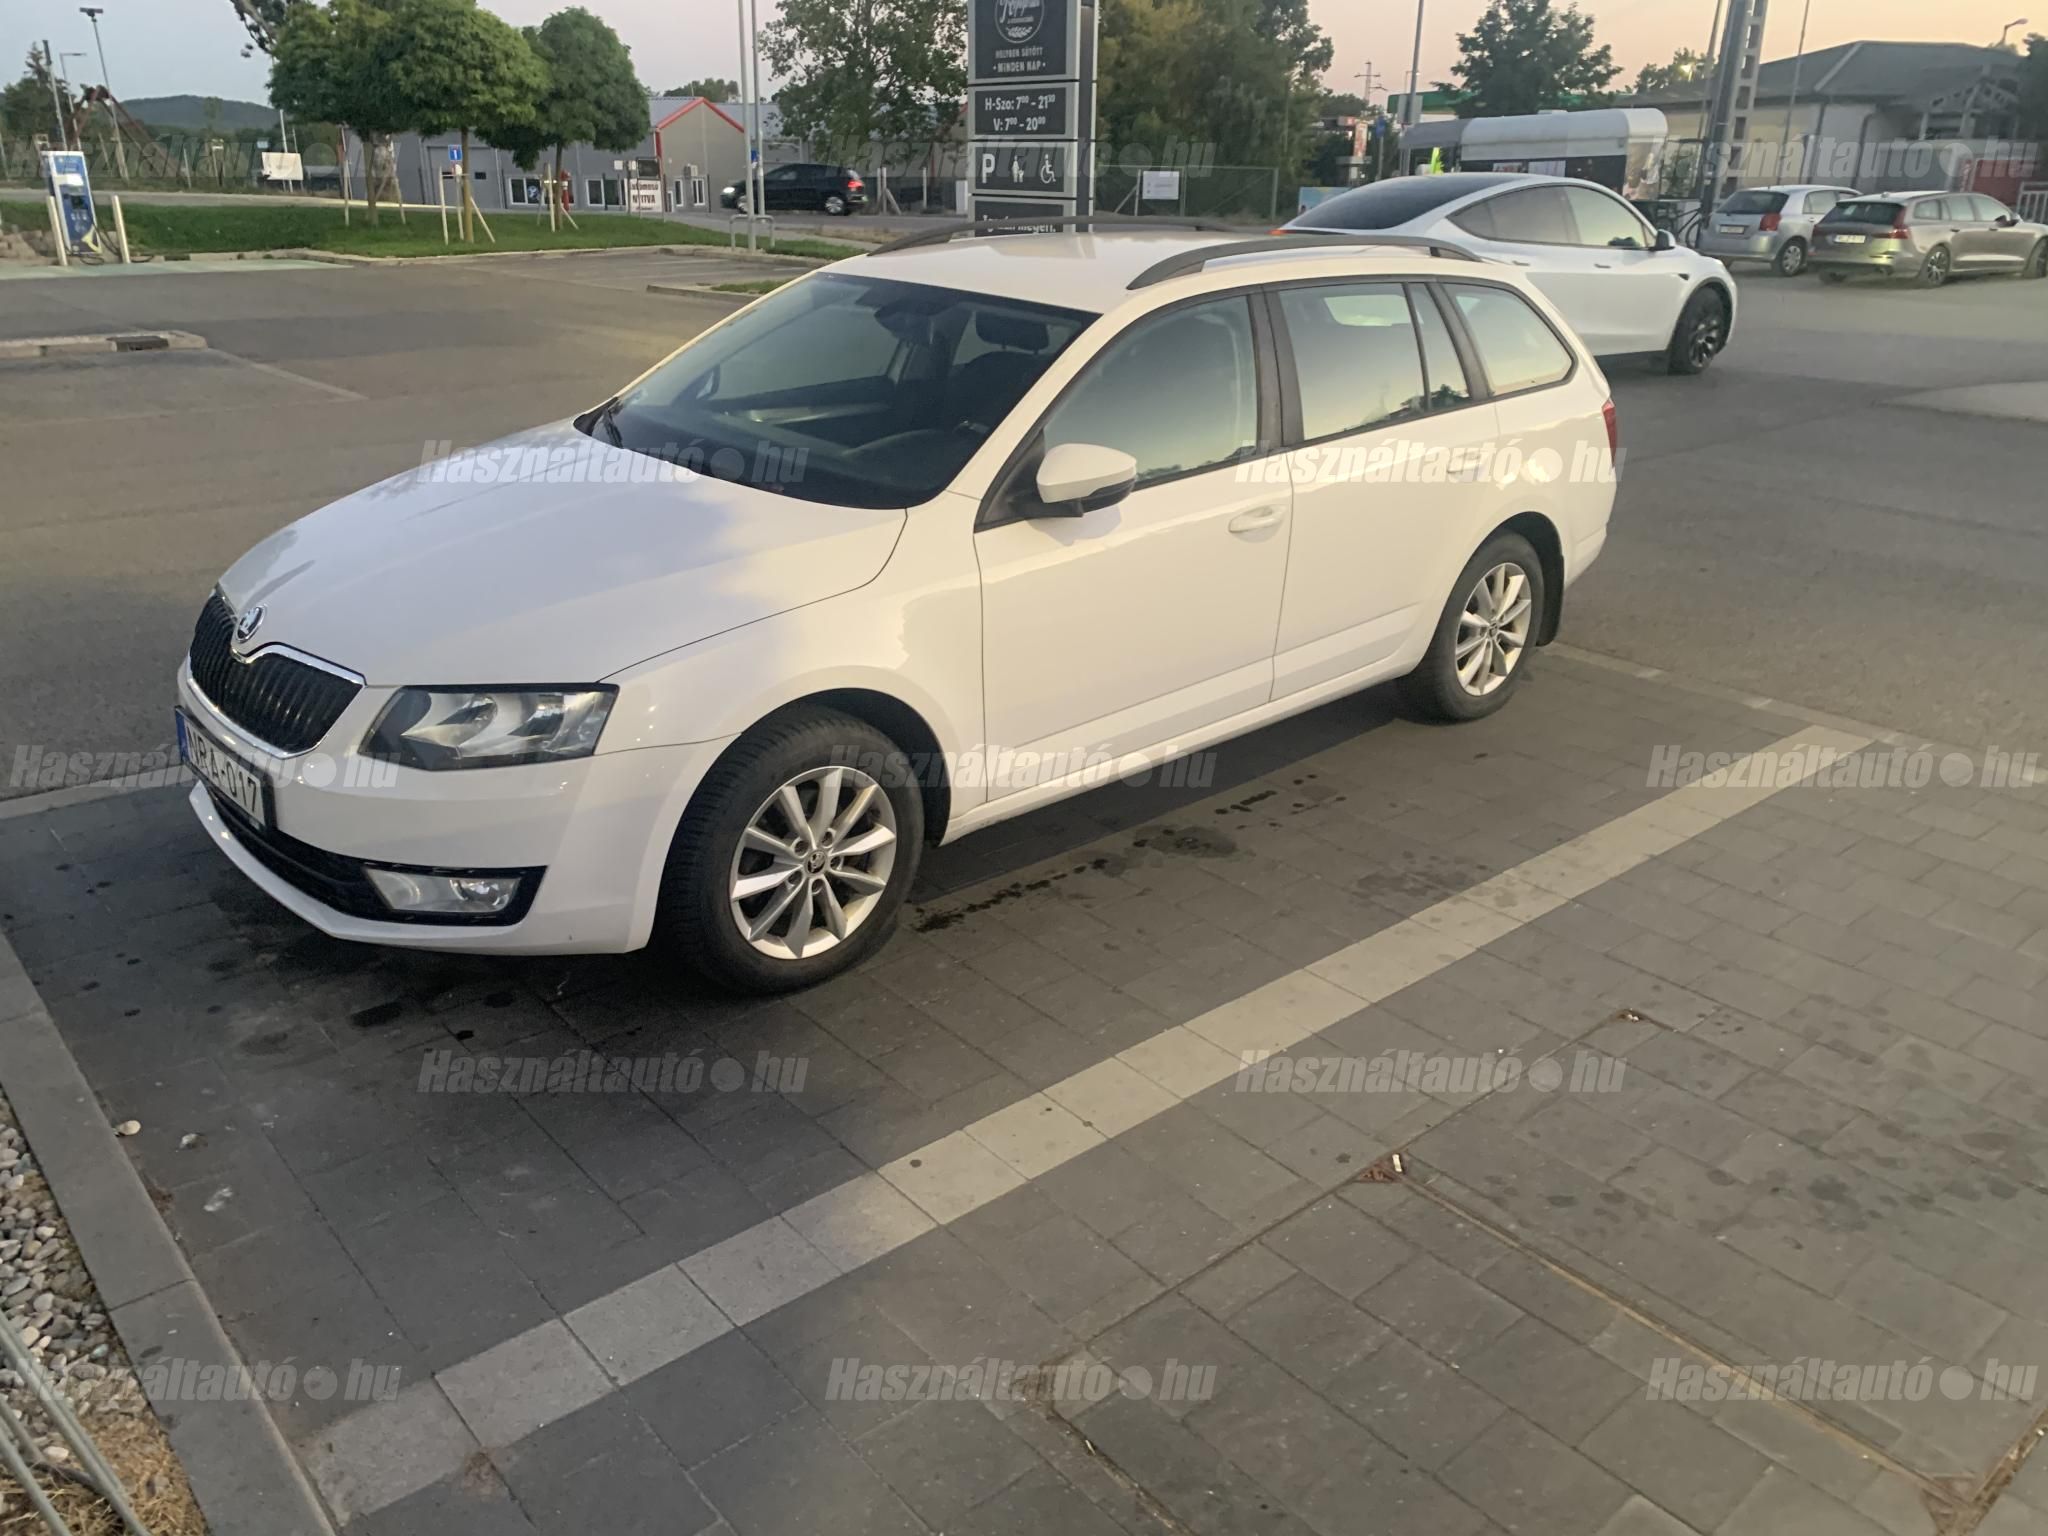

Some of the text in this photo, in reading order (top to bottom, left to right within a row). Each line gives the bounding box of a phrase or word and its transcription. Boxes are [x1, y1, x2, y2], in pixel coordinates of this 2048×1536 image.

[985, 97, 1014, 110] H-Szo:
[993, 118, 1003, 131] V:
[982, 153, 996, 183] P
